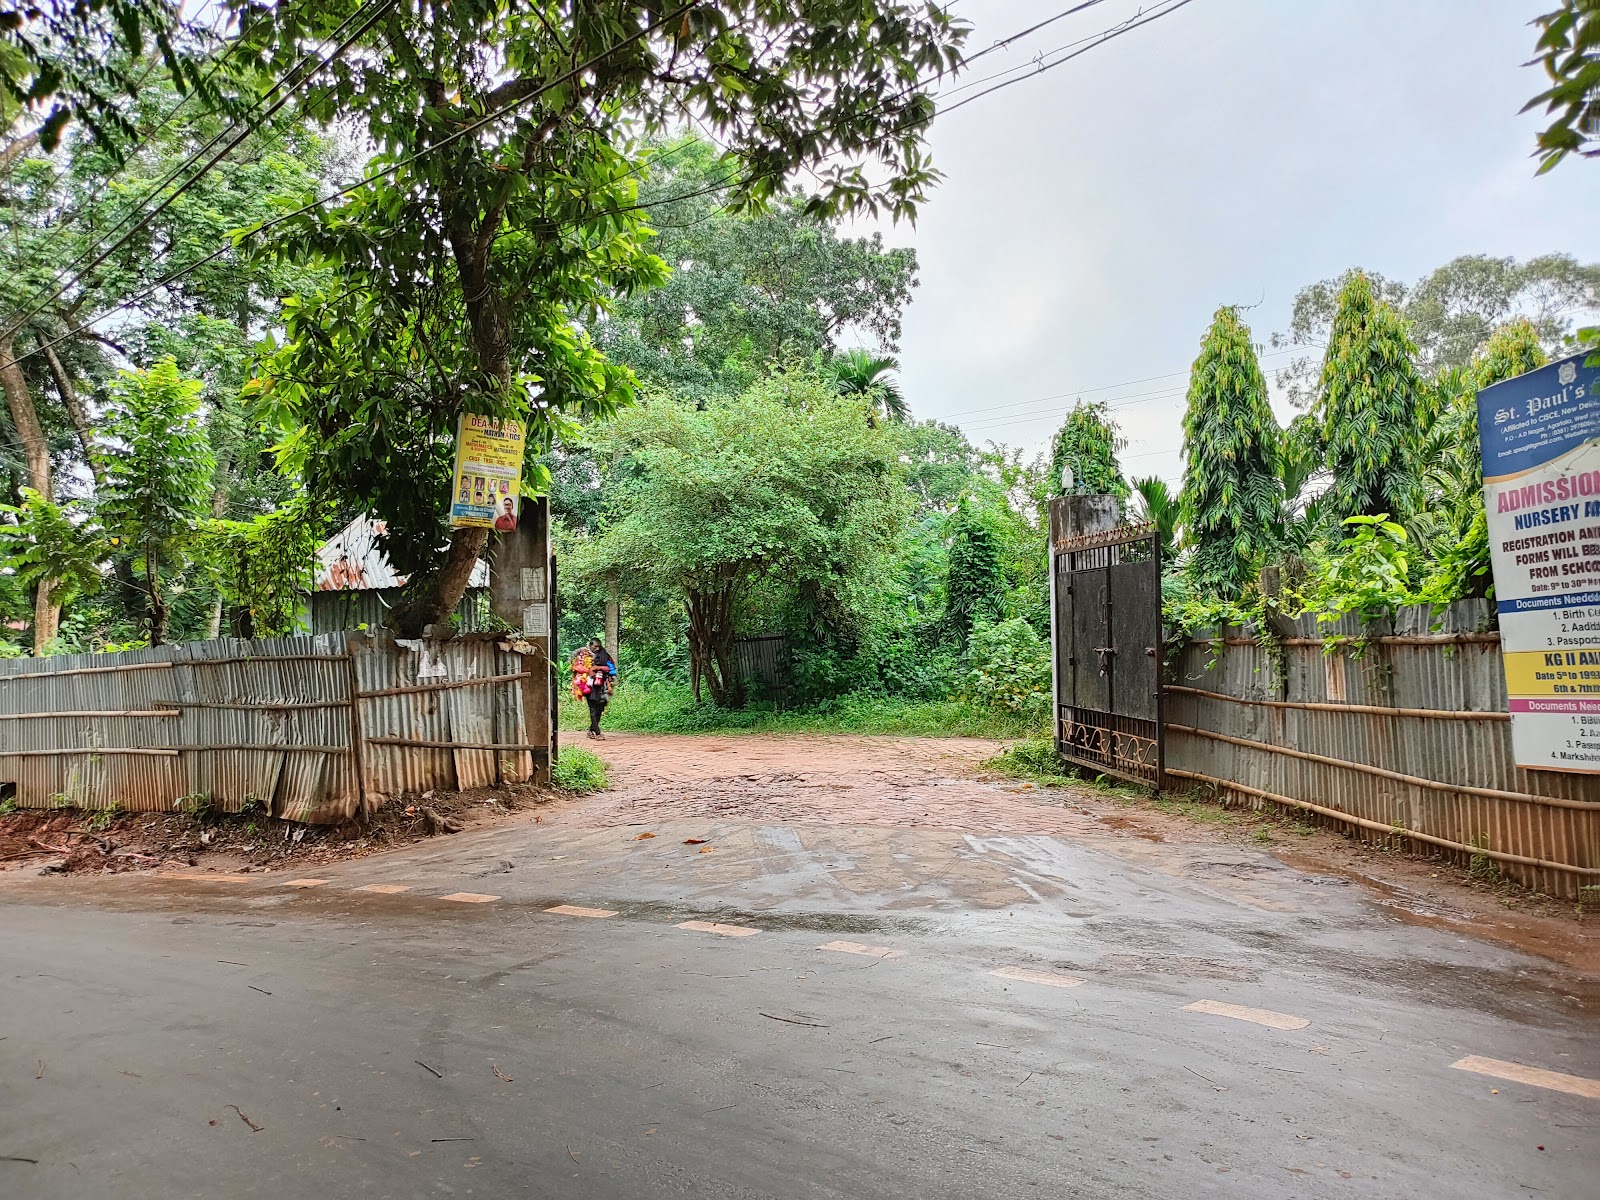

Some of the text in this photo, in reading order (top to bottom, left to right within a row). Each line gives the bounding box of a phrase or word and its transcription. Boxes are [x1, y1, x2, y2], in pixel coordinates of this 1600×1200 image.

[1494, 384, 1585, 425] St. Paul's
[1501, 419, 1530, 434] (Affiliated
[1561, 406, 1578, 415] New
[1574, 413, 1589, 422] West
[1514, 503, 1580, 530] NURSERY
[1502, 530, 1575, 553] REGISTRATION
[1515, 550, 1550, 566] FORMS
[1551, 546, 1579, 560] WILL
[1529, 565, 1559, 580] FROM
[1531, 584, 1550, 593] Date:
[1561, 581, 1570, 589] to
[1516, 596, 1562, 609] Documents
[1552, 611, 1561, 620] 1.
[1562, 609, 1585, 619] Birth
[1561, 623, 1570, 633] 2.
[1546, 637, 1556, 646] 3.
[1544, 652, 1563, 667] KG
[1565, 652, 1576, 666] II
[1535, 671, 1555, 680] Date
[1568, 671, 1577, 680] to
[1553, 684, 1569, 693] 6th
[1528, 700, 1577, 711] Documents
[1571, 715, 1579, 725] 1.
[1580, 728, 1588, 737] 2.
[1566, 739, 1574, 749] 3.
[1551, 751, 1559, 760] 4.
